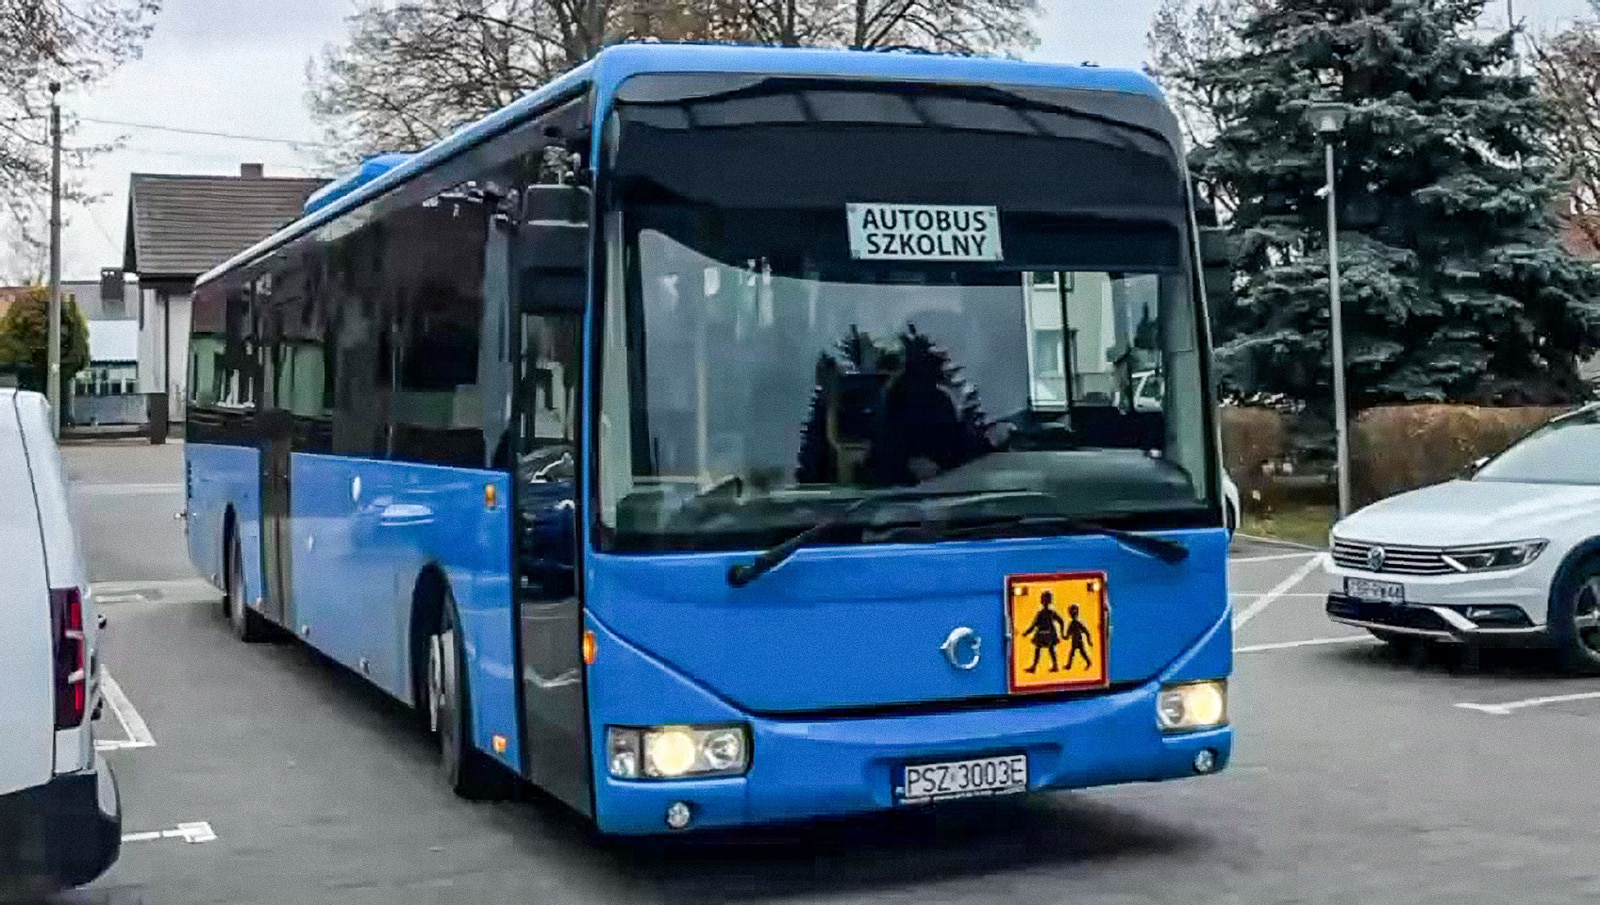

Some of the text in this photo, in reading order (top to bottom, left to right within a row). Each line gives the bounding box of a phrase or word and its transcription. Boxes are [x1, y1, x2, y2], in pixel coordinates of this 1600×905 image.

[862, 208, 987, 232] AUTOBUS
[866, 233, 986, 256] SZKOLNY
[907, 758, 1024, 794] PSZ 3003E
